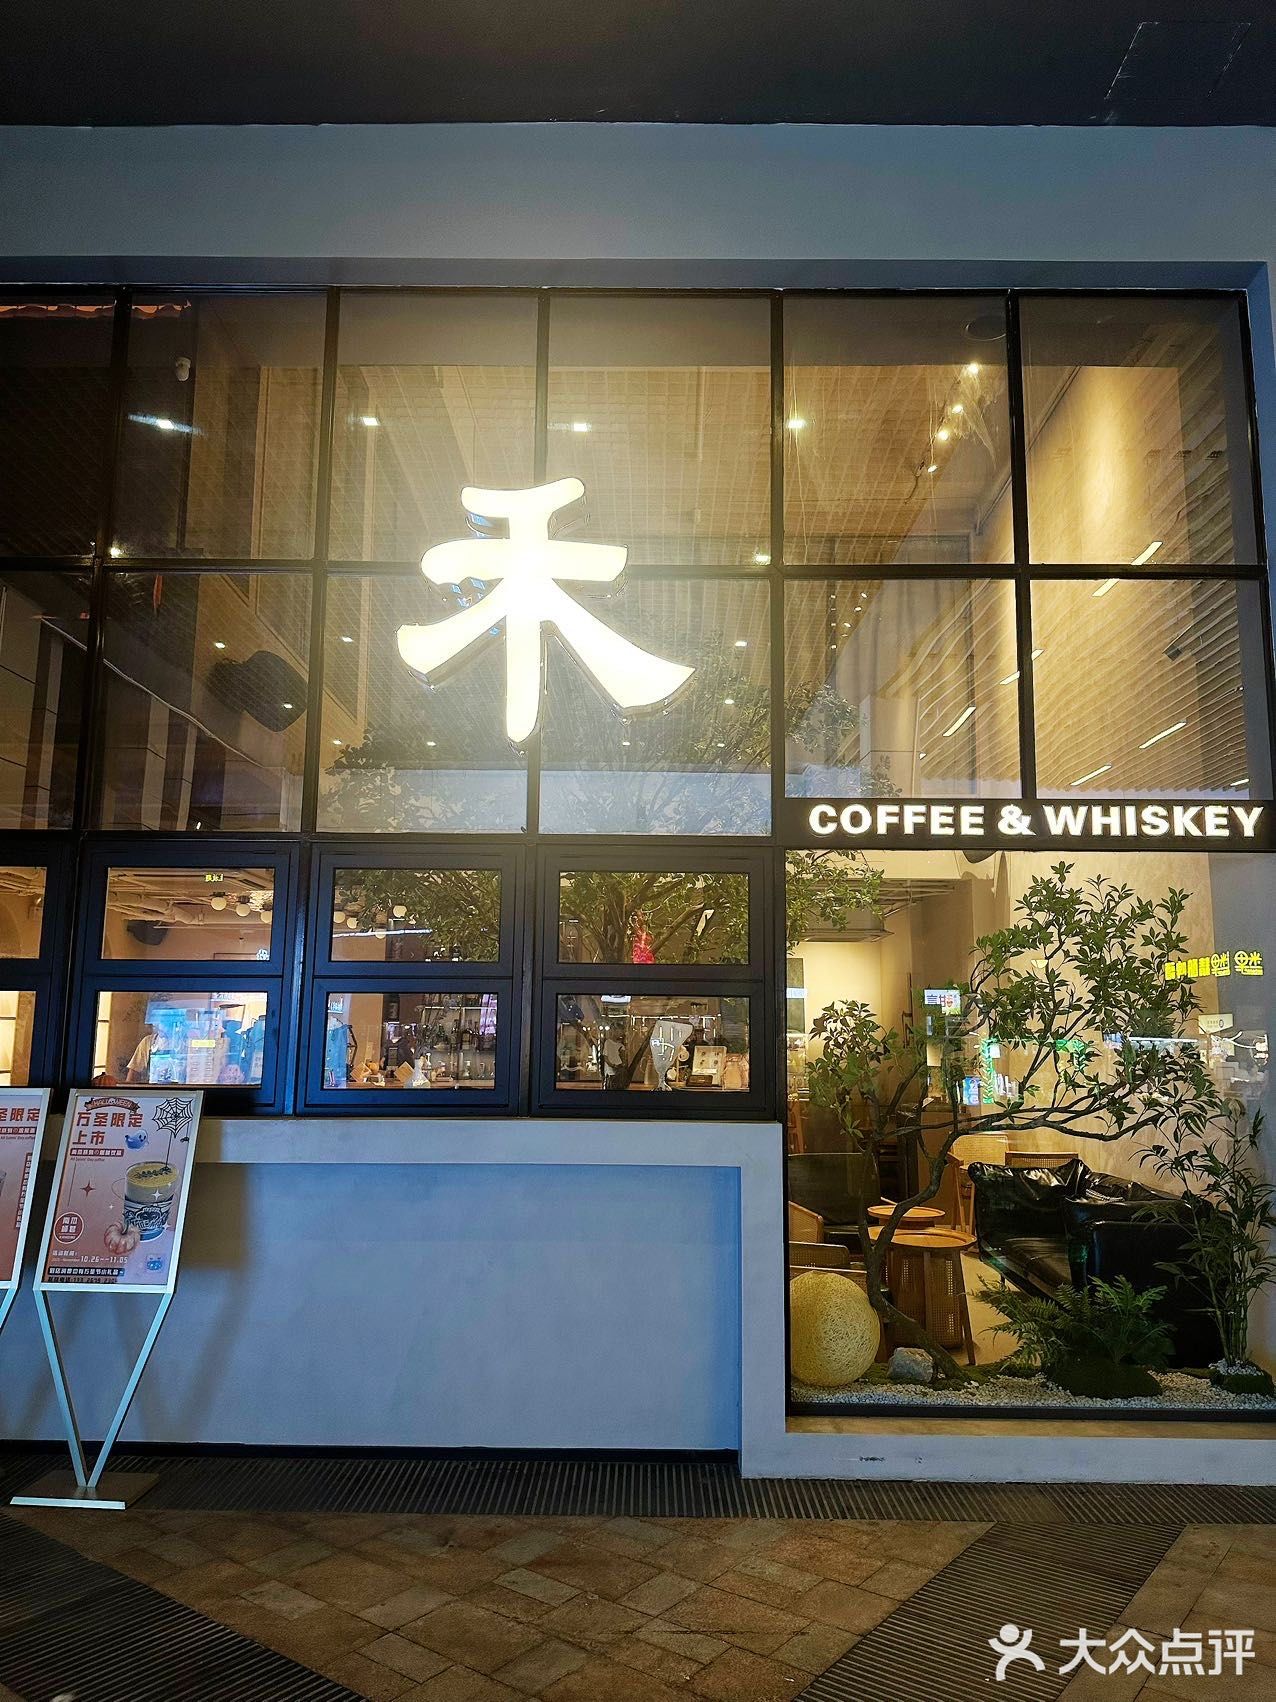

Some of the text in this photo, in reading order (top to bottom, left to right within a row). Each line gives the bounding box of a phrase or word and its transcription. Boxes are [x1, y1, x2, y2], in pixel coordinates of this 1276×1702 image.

[396, 477, 696, 744] 禾
[809, 803, 1264, 838] COFFEE & WHISKEY
[76, 1112, 144, 1128] 万圣限定
[72, 1131, 106, 1145] 上市
